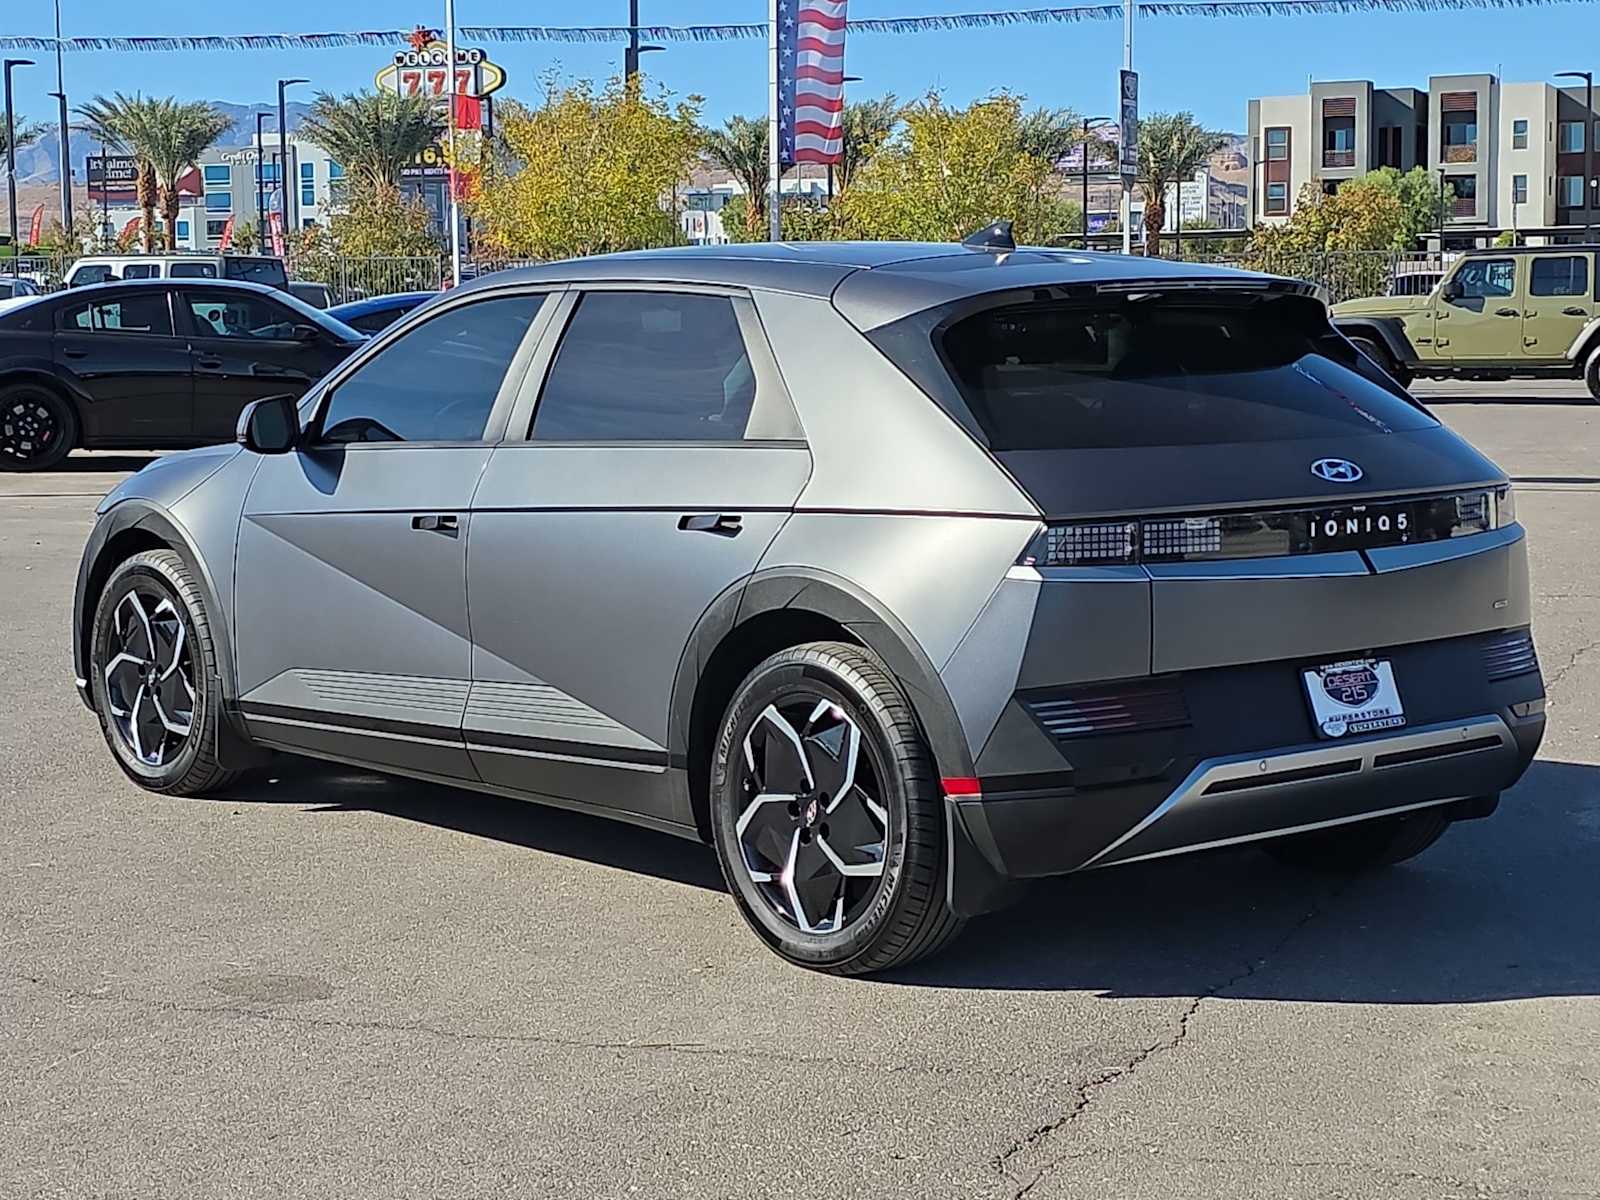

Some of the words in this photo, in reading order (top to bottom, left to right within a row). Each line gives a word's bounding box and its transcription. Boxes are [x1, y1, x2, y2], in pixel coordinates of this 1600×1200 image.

[105, 168, 132, 179] ime!
[1326, 671, 1371, 688] DESERT
[1341, 685, 1367, 702] 215
[1328, 708, 1391, 722] SUPERSTORE
